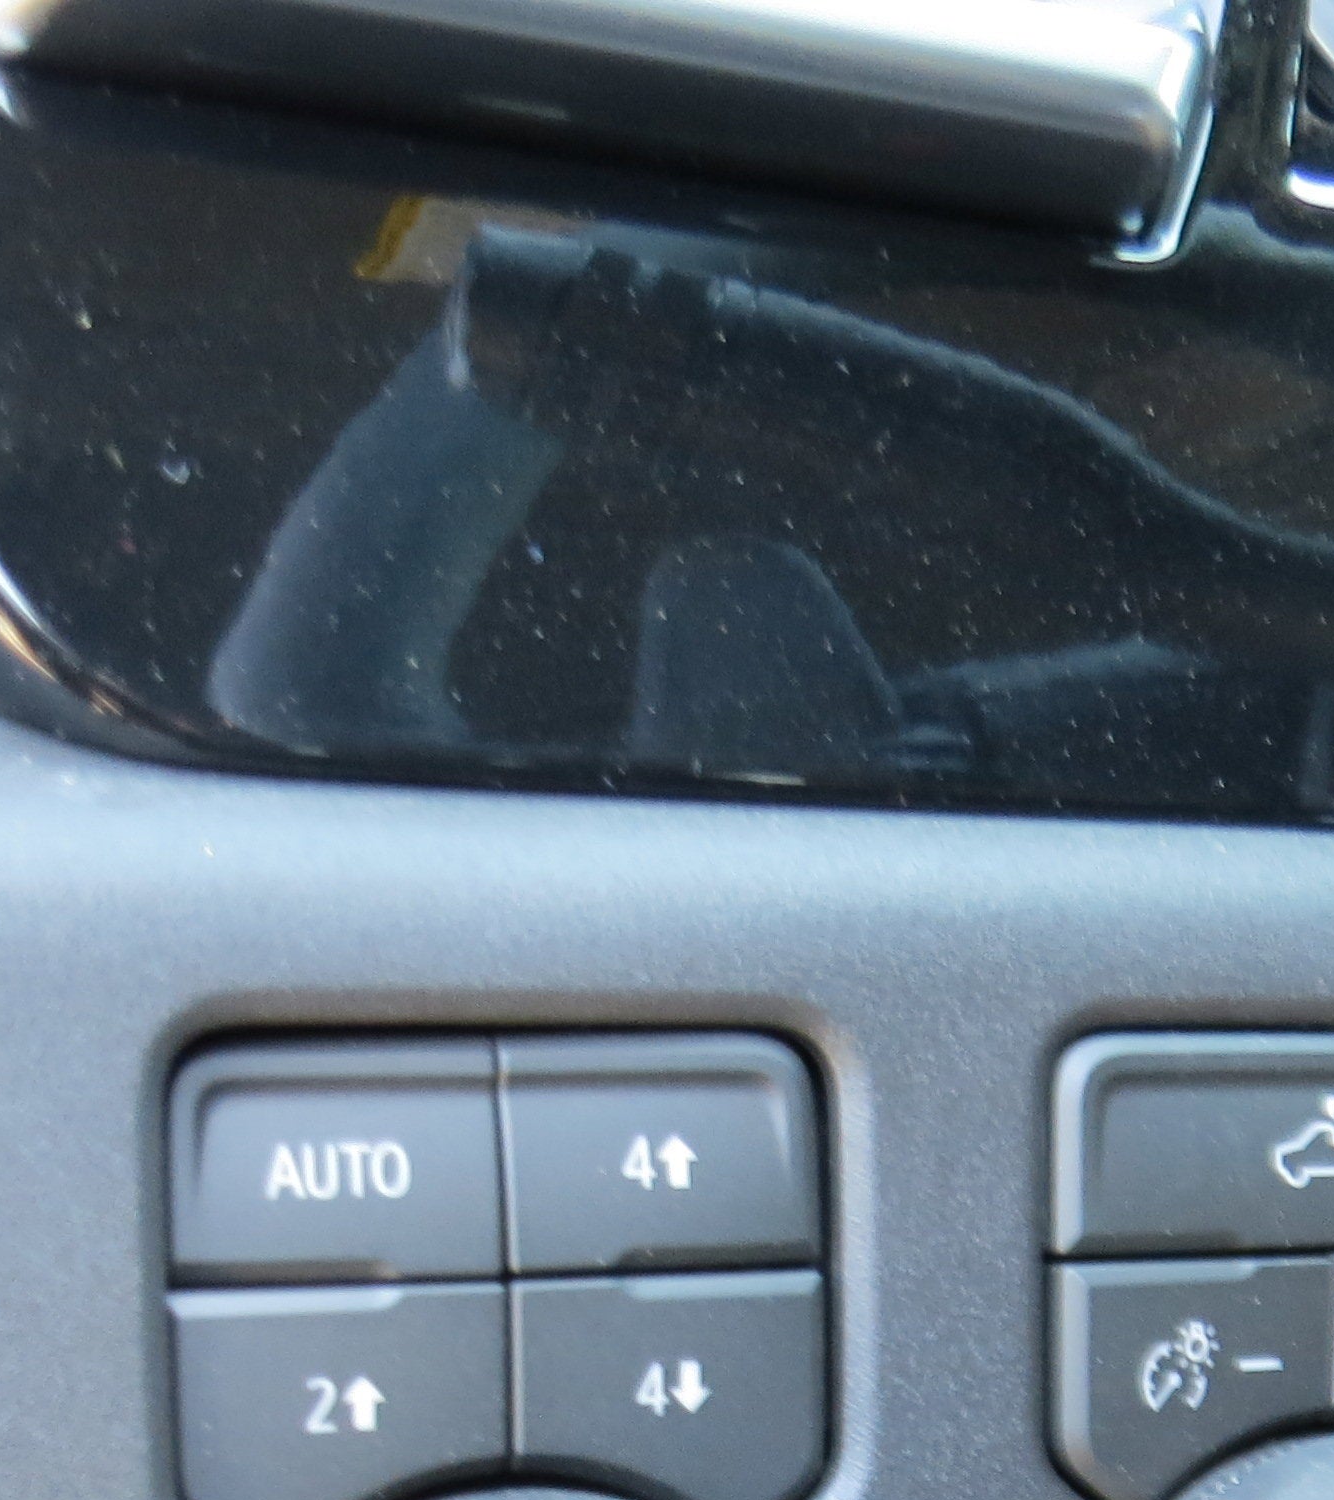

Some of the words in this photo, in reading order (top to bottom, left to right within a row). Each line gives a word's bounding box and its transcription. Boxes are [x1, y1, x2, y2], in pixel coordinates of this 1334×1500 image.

[266, 1140, 412, 1200] AUTO
[621, 1134, 656, 1192] 4
[303, 1377, 339, 1434] 2
[634, 1361, 668, 1417] 4
